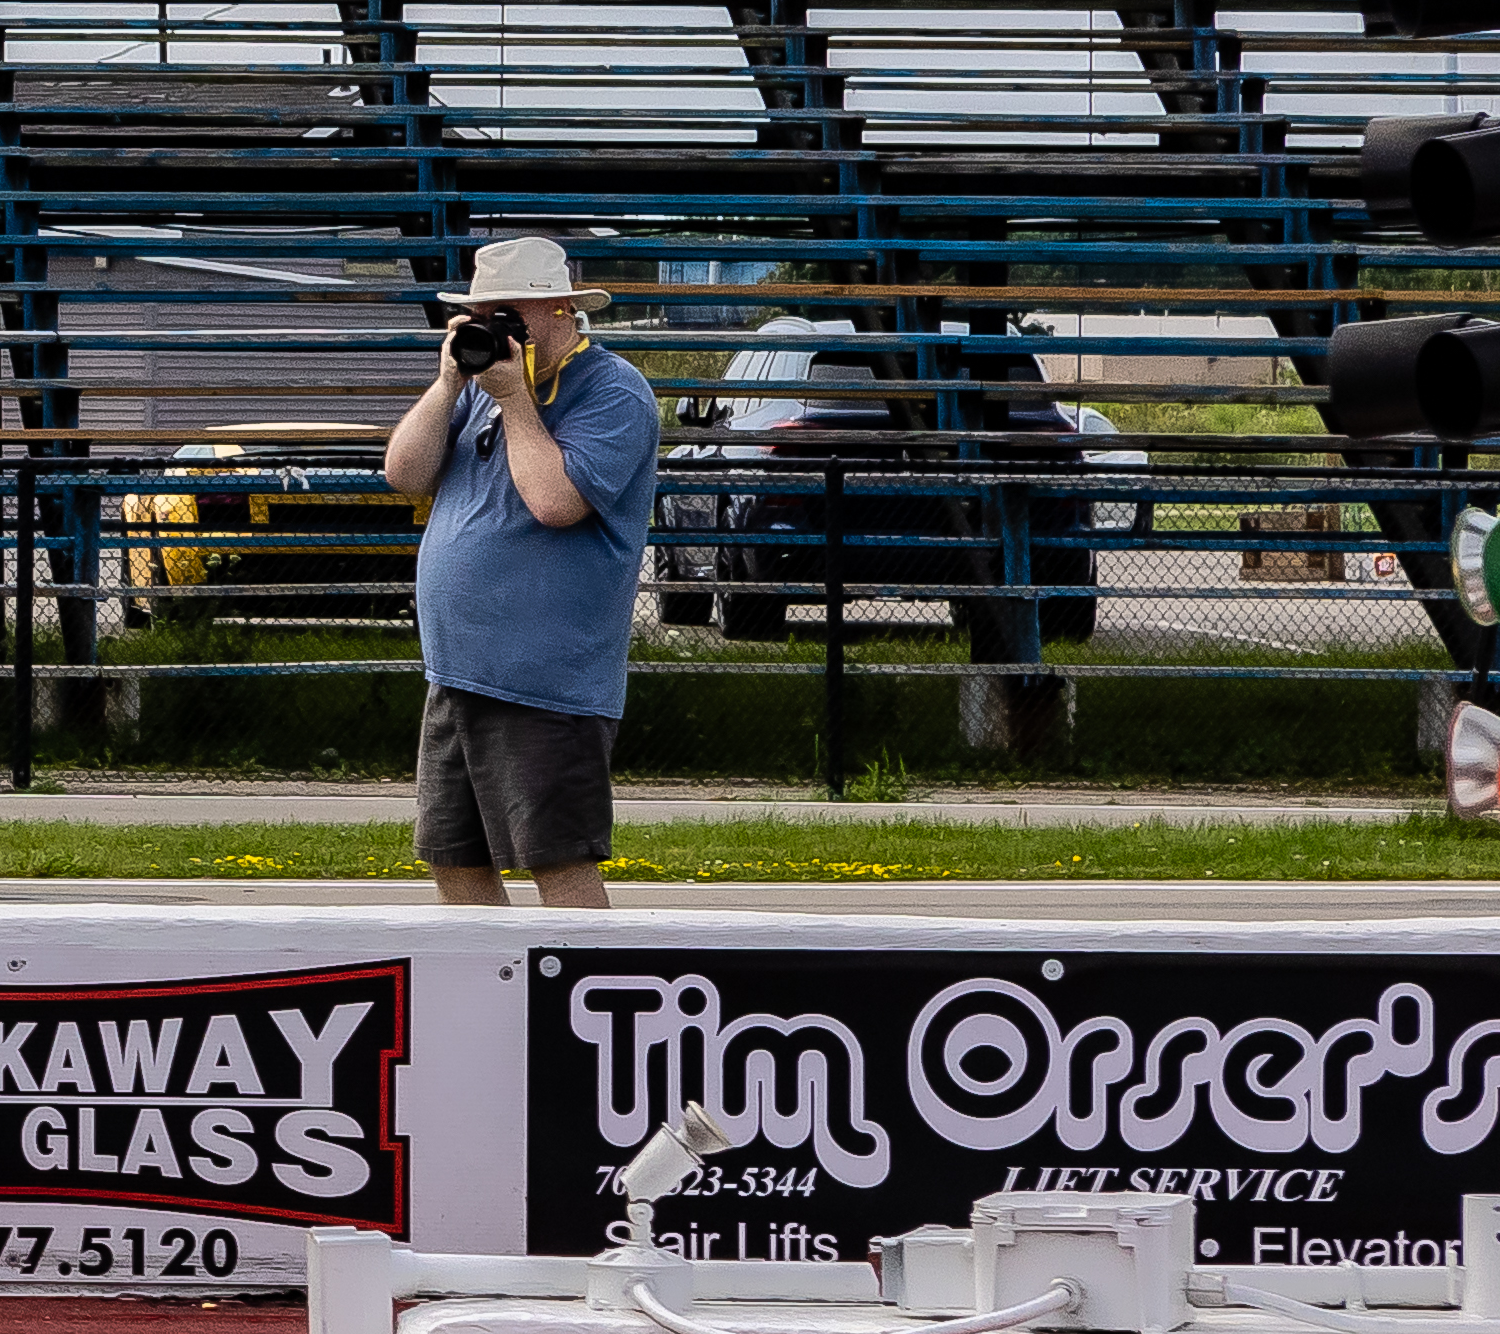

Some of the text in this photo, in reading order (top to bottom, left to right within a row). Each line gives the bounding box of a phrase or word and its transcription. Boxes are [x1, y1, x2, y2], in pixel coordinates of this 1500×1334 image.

[570, 973, 1500, 1188] Tim Orser's
[20, 1107, 371, 1199] GLASS
[1129, 1167, 1346, 1203] SERVICE
[604, 1220, 840, 1263] Sair Lifts
